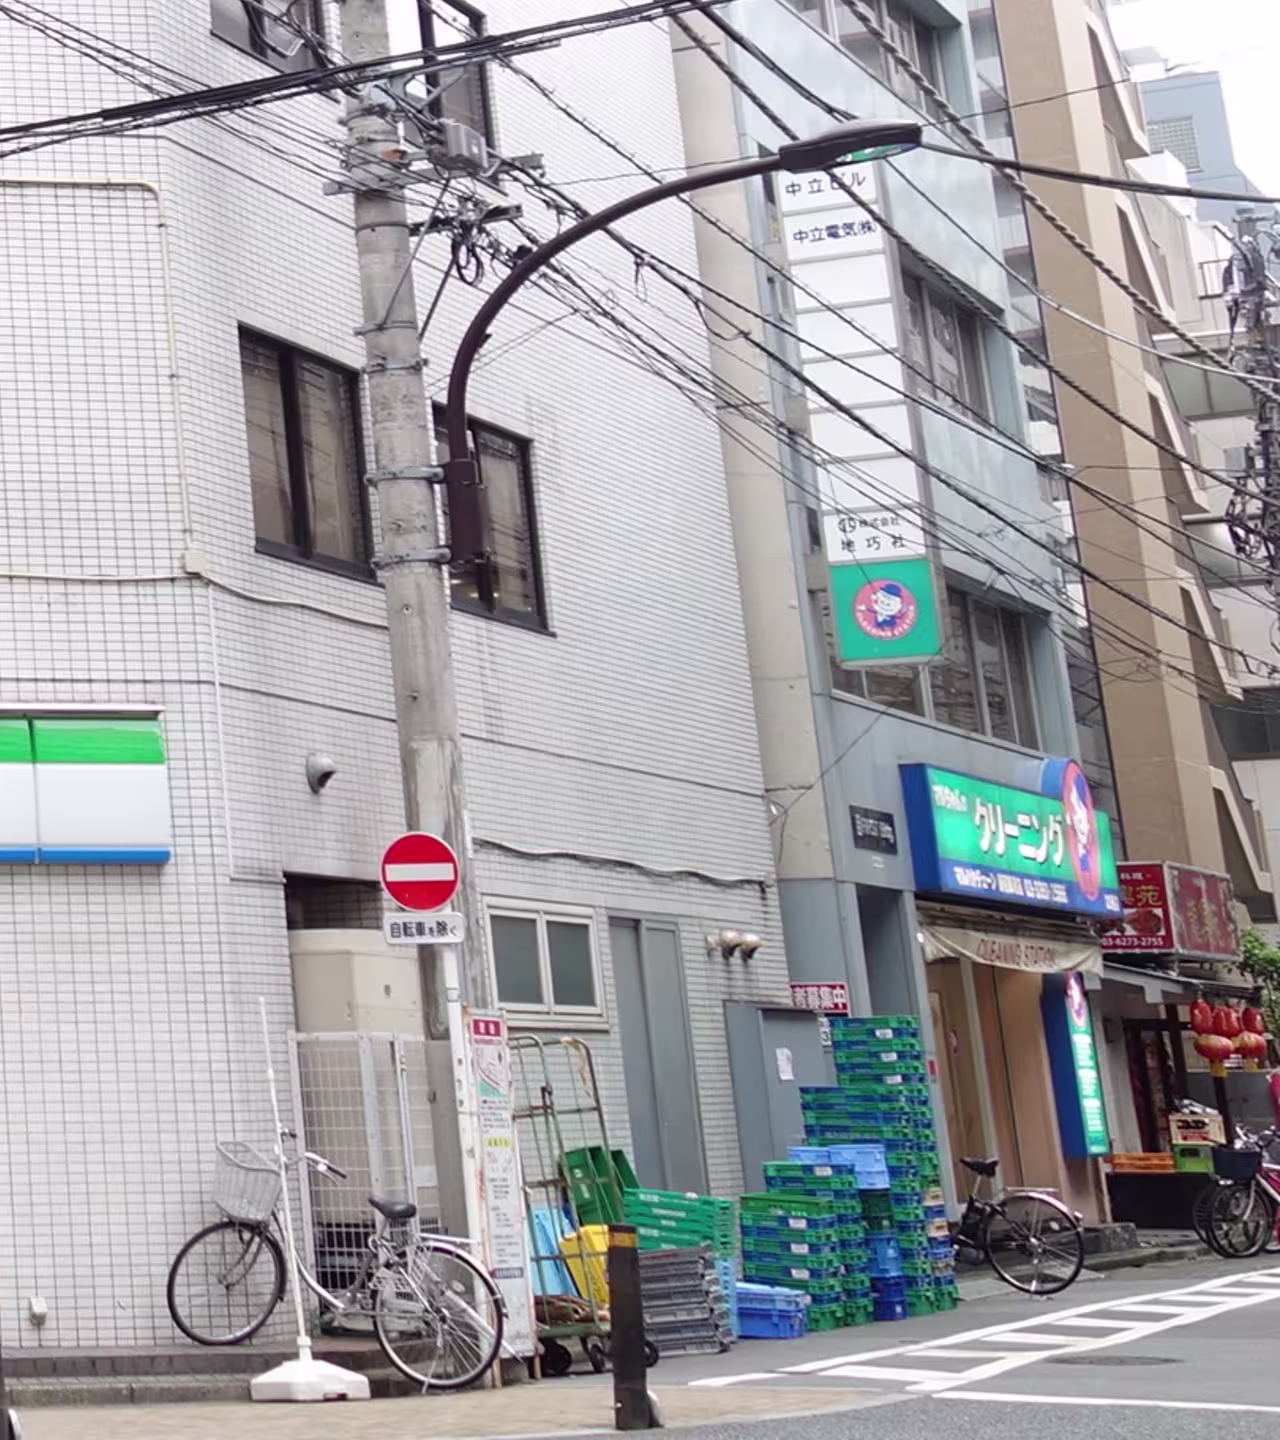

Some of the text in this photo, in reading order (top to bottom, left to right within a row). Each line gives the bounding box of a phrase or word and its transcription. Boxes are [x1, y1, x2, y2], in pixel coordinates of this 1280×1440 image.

[974, 797, 1064, 868] クリーニング
[390, 920, 457, 939] 自転車を除く
